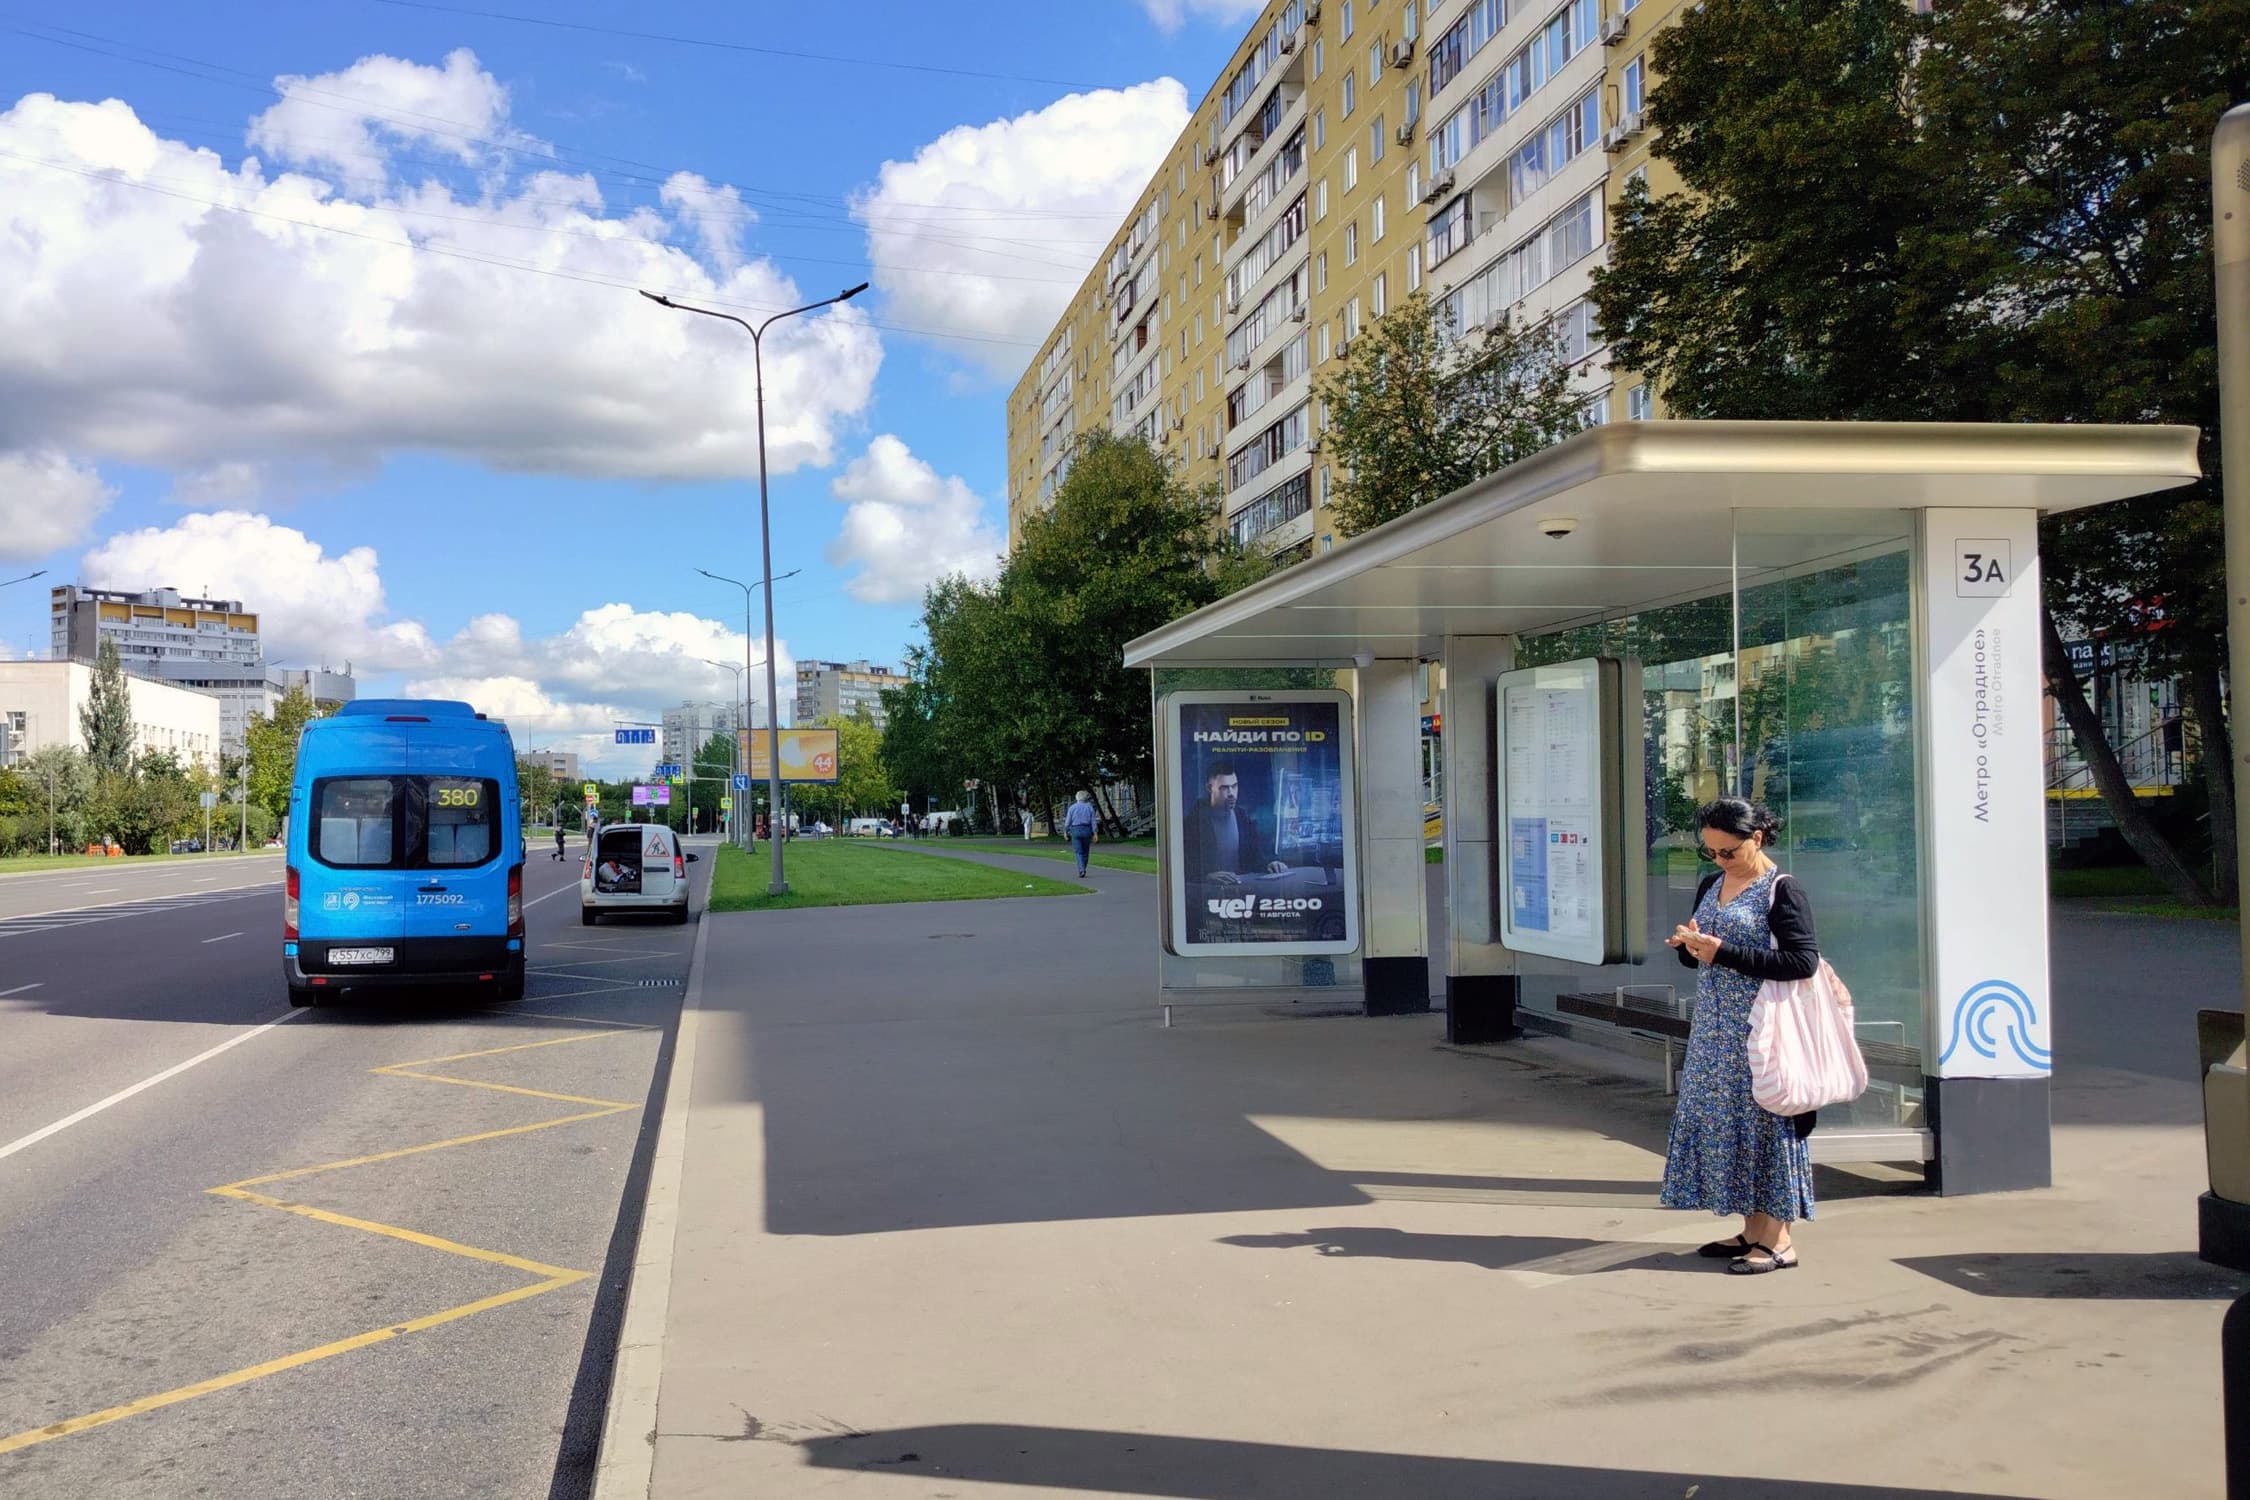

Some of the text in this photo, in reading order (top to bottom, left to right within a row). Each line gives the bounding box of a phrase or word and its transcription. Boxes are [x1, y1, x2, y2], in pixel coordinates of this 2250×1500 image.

[1964, 554, 2004, 583] 3А
[1991, 628, 2003, 737] Metro Otradnoe
[1972, 629, 1991, 823] Метро «Отрадное»
[1194, 729, 1326, 743] НАЙДИ ПО ID
[814, 755, 833, 768] 44
[438, 789, 478, 806] 380
[416, 894, 464, 905] 1775092
[1259, 898, 1323, 911] 22:00
